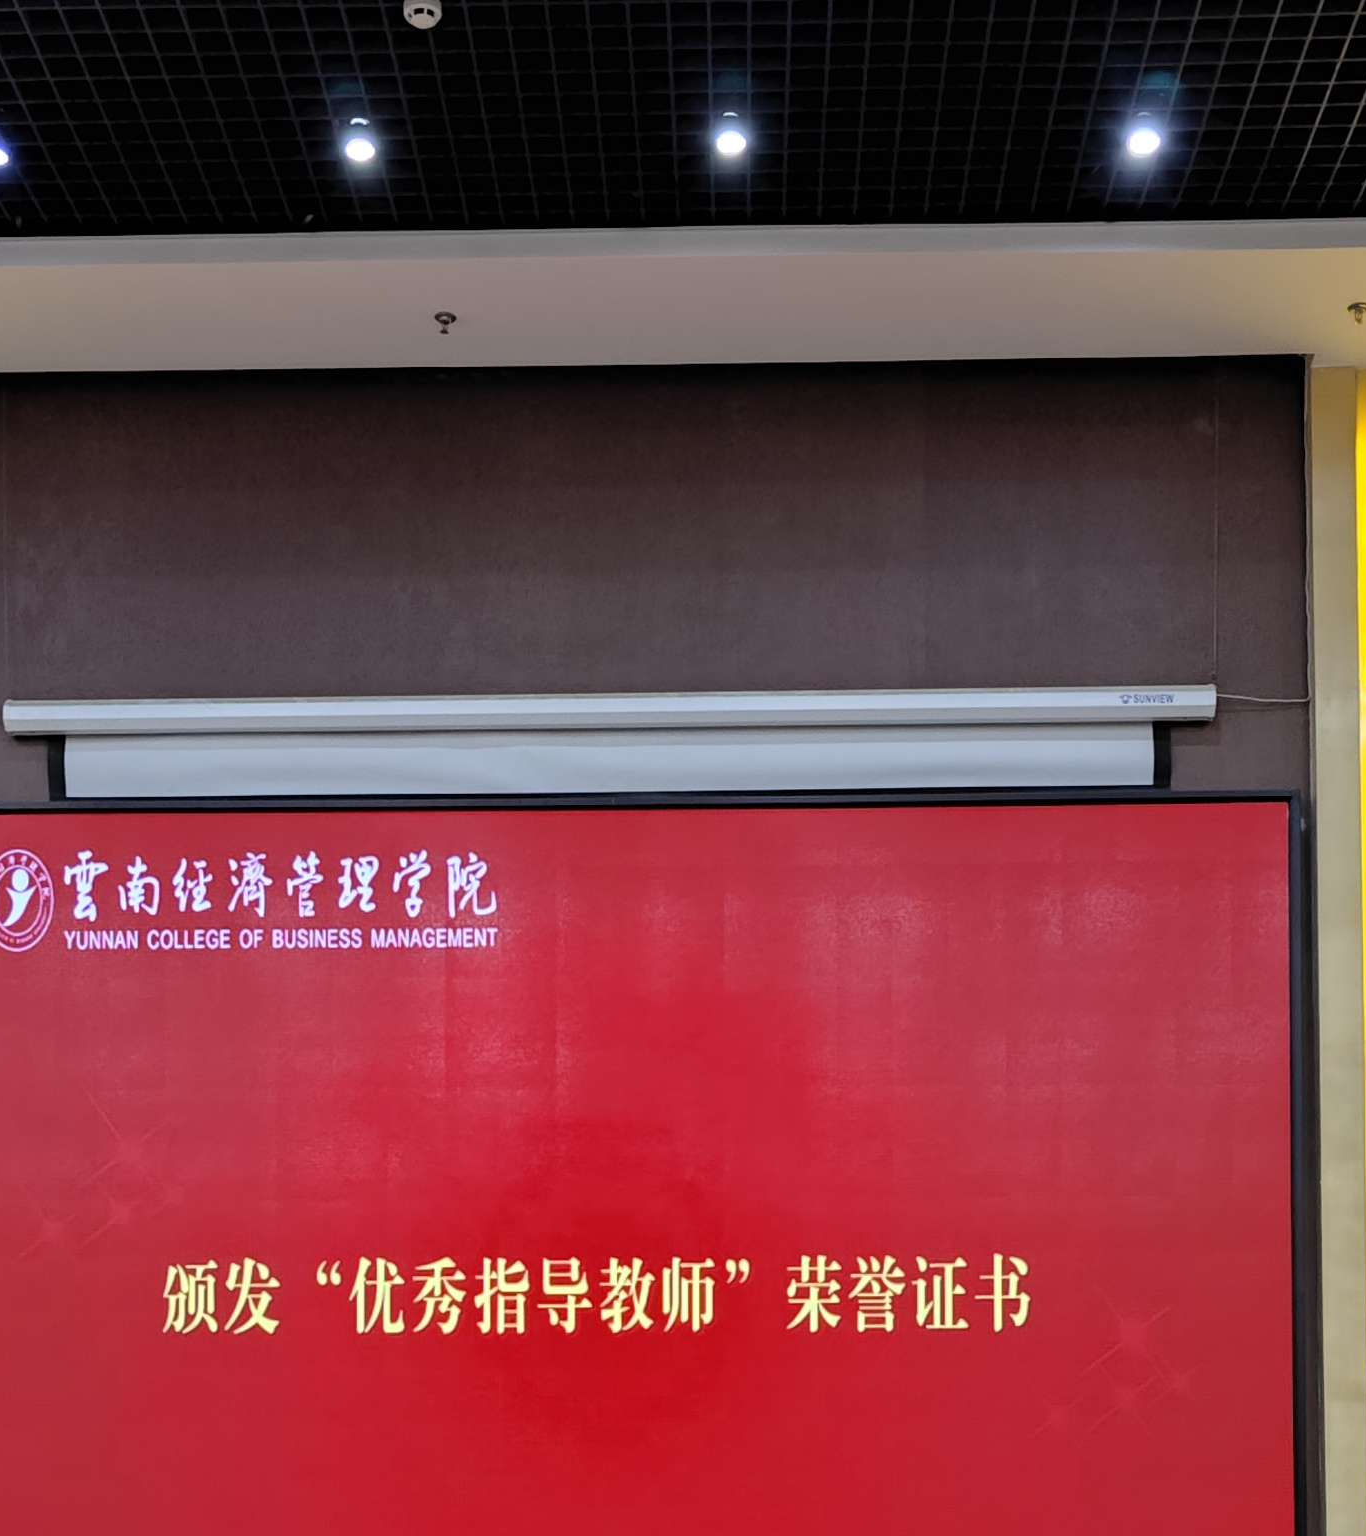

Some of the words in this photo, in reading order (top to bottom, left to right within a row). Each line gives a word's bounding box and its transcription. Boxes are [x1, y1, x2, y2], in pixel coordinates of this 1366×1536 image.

[1133, 693, 1174, 703] SUNVIEW
[63, 930, 138, 950] YUNNAN
[146, 929, 231, 950] COLLEGE
[239, 929, 264, 949] OF
[272, 928, 363, 949] BUSINESS
[370, 927, 498, 948] MANAGEMENT
